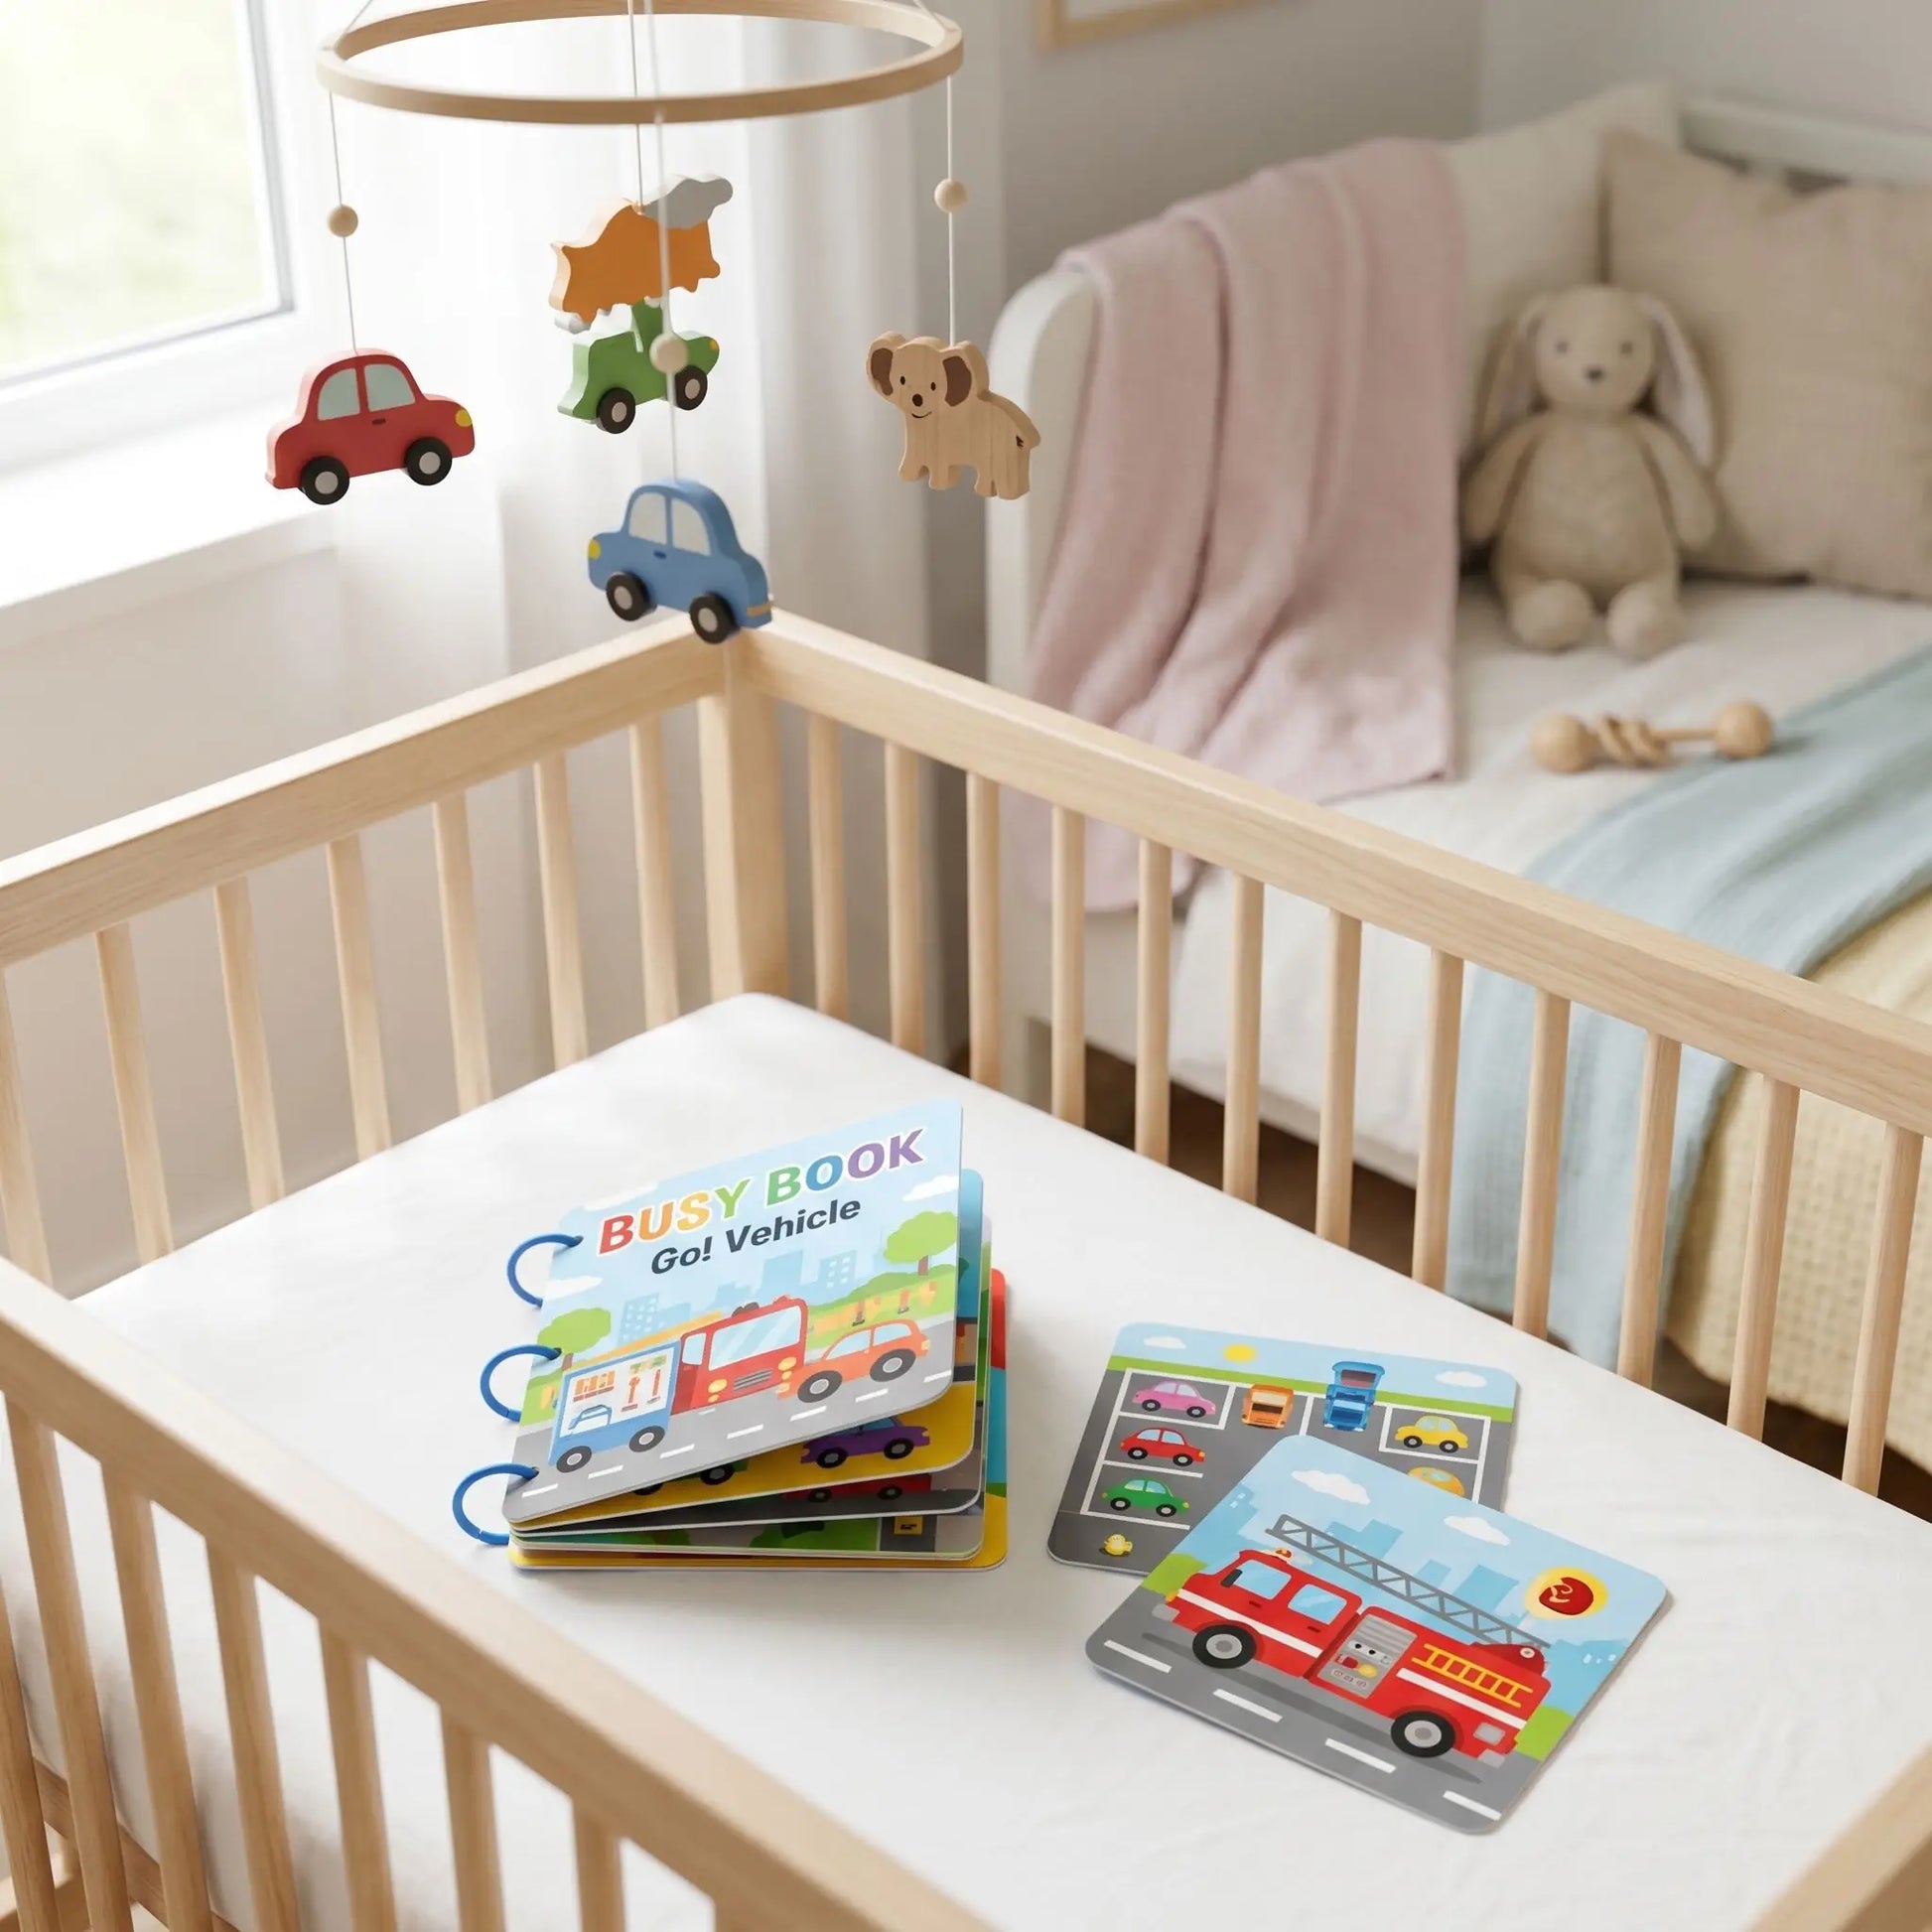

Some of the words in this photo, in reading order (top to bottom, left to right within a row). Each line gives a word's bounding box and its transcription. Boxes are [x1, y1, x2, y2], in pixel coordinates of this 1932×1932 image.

[599, 1179, 750, 1254] BUSY
[766, 1129, 924, 1206] BOOK
[651, 1236, 713, 1275] Go!
[726, 1199, 862, 1253] Vehicle
